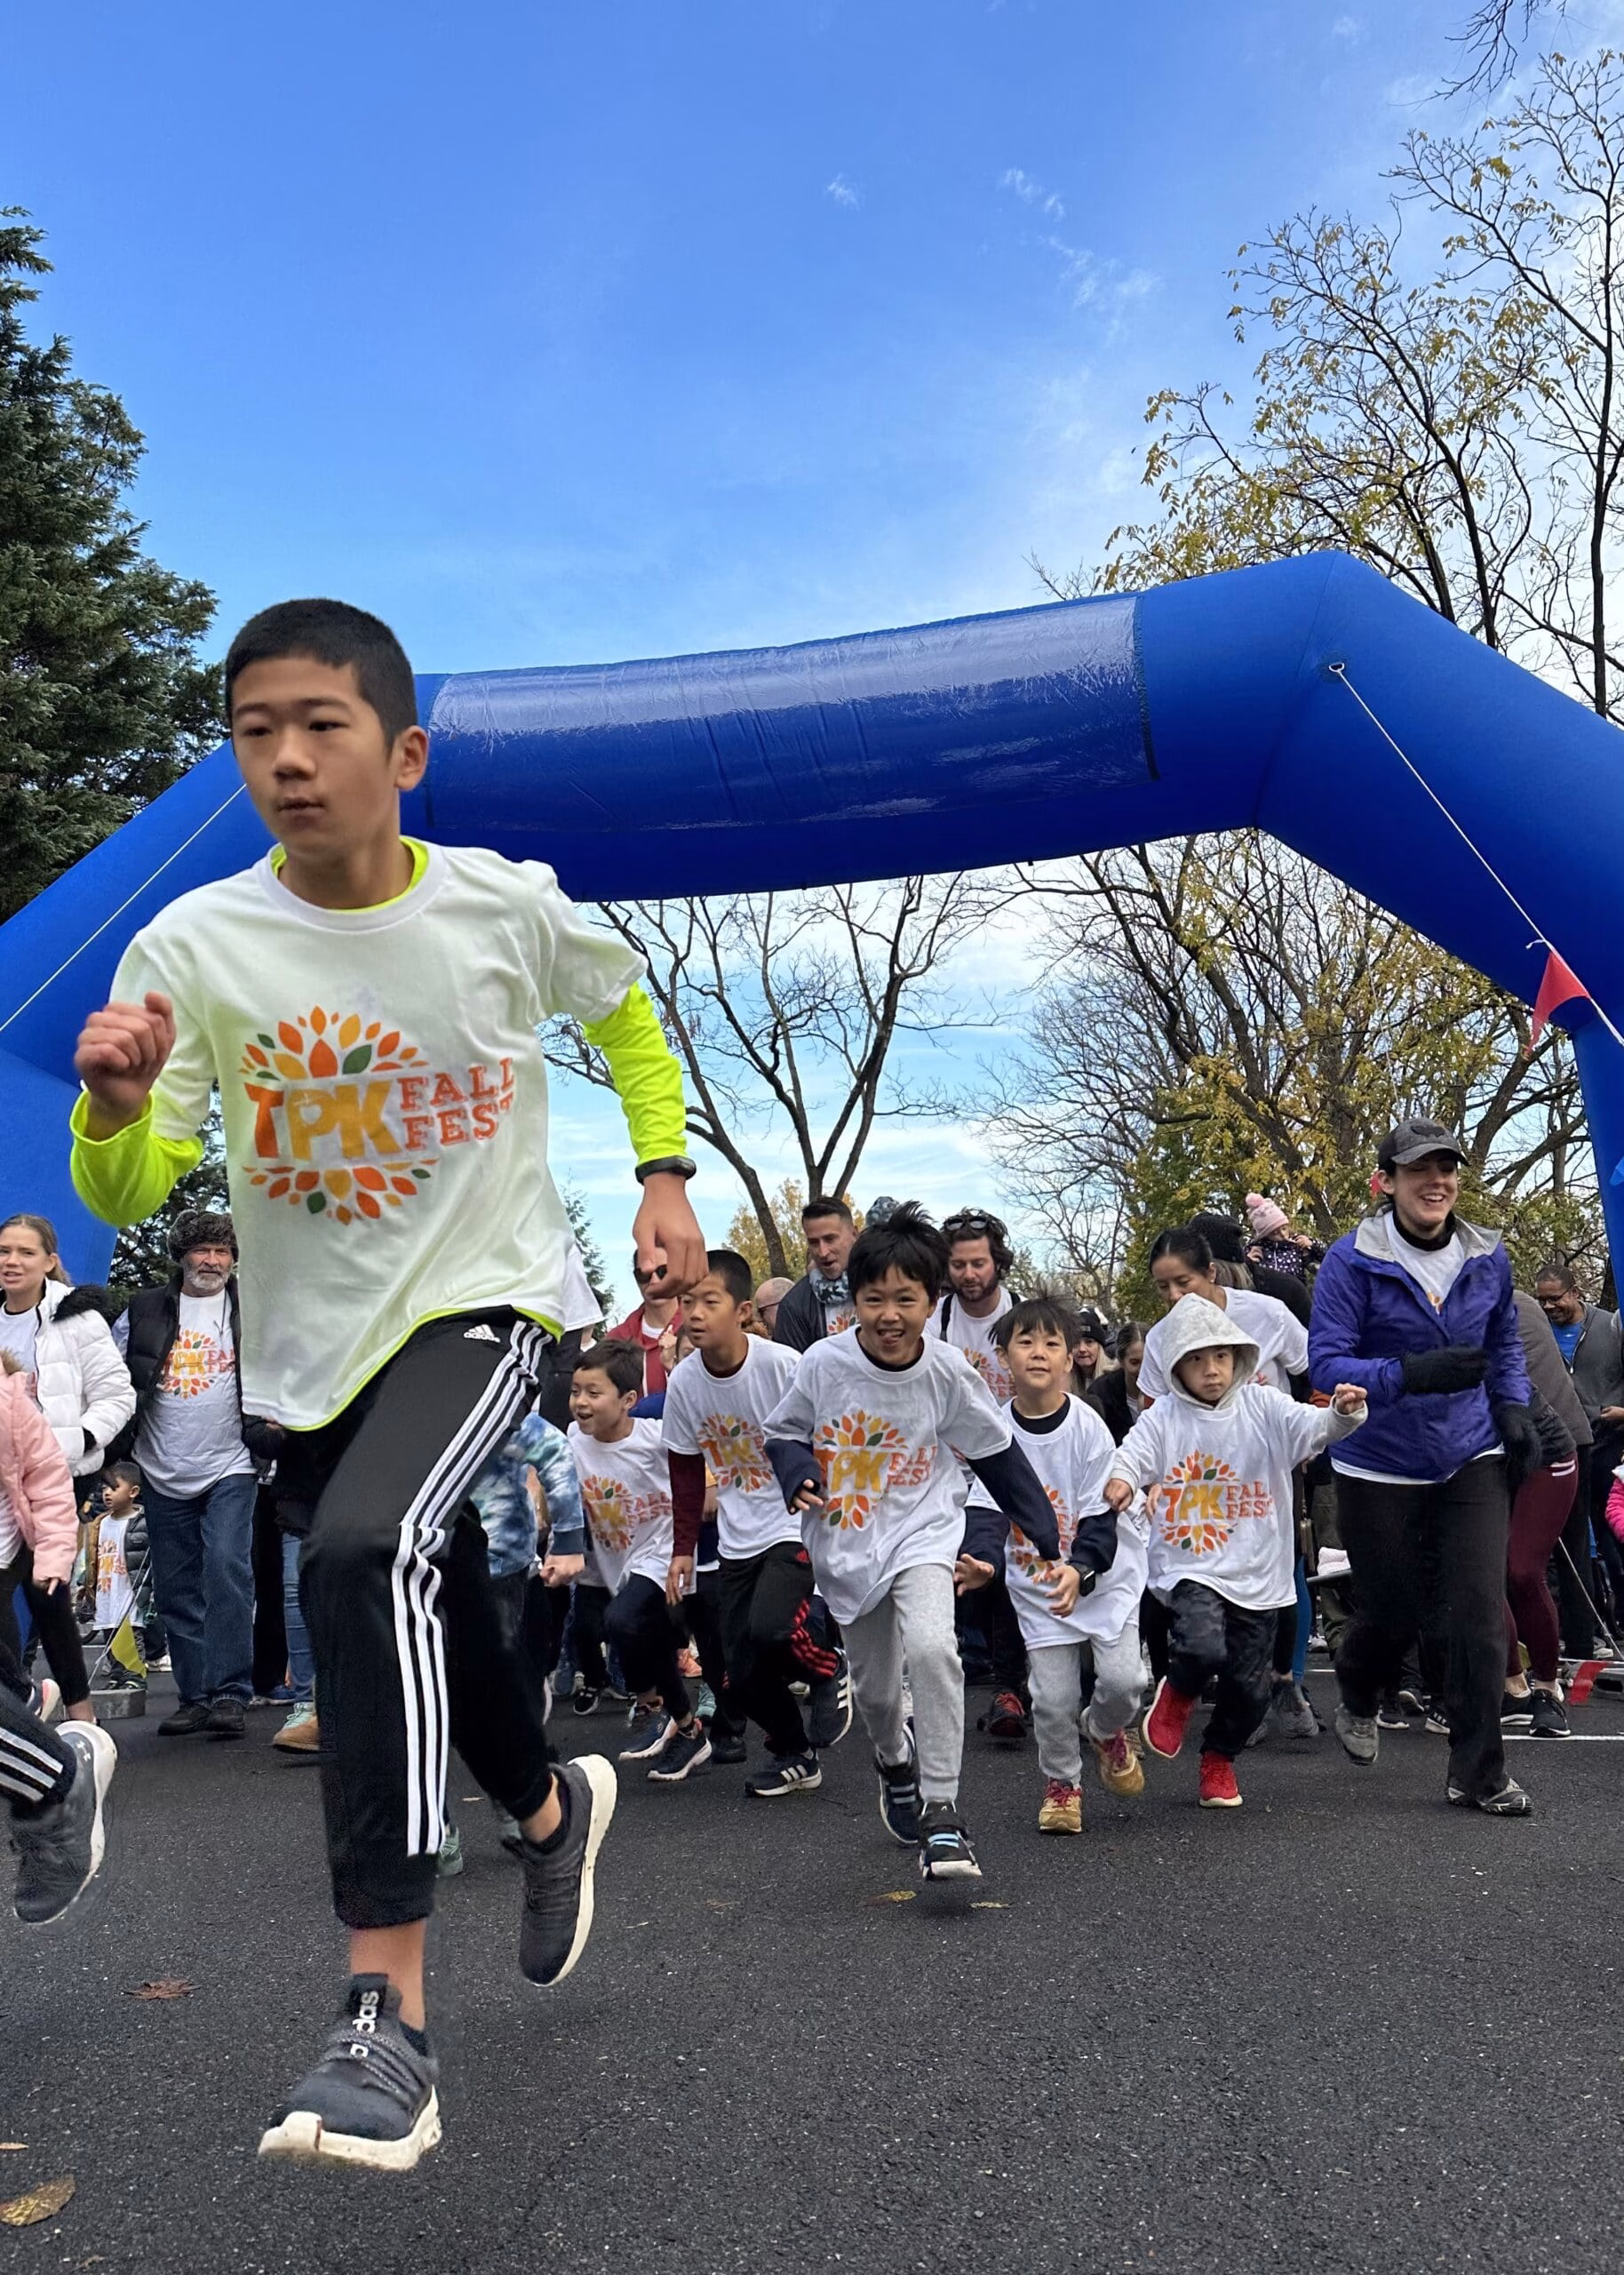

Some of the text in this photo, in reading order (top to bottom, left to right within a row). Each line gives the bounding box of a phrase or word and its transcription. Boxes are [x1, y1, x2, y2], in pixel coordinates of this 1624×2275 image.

[397, 1057, 515, 1113] FALL
[243, 1080, 403, 1161] TPK
[1225, 1480, 1272, 1500] FAL
